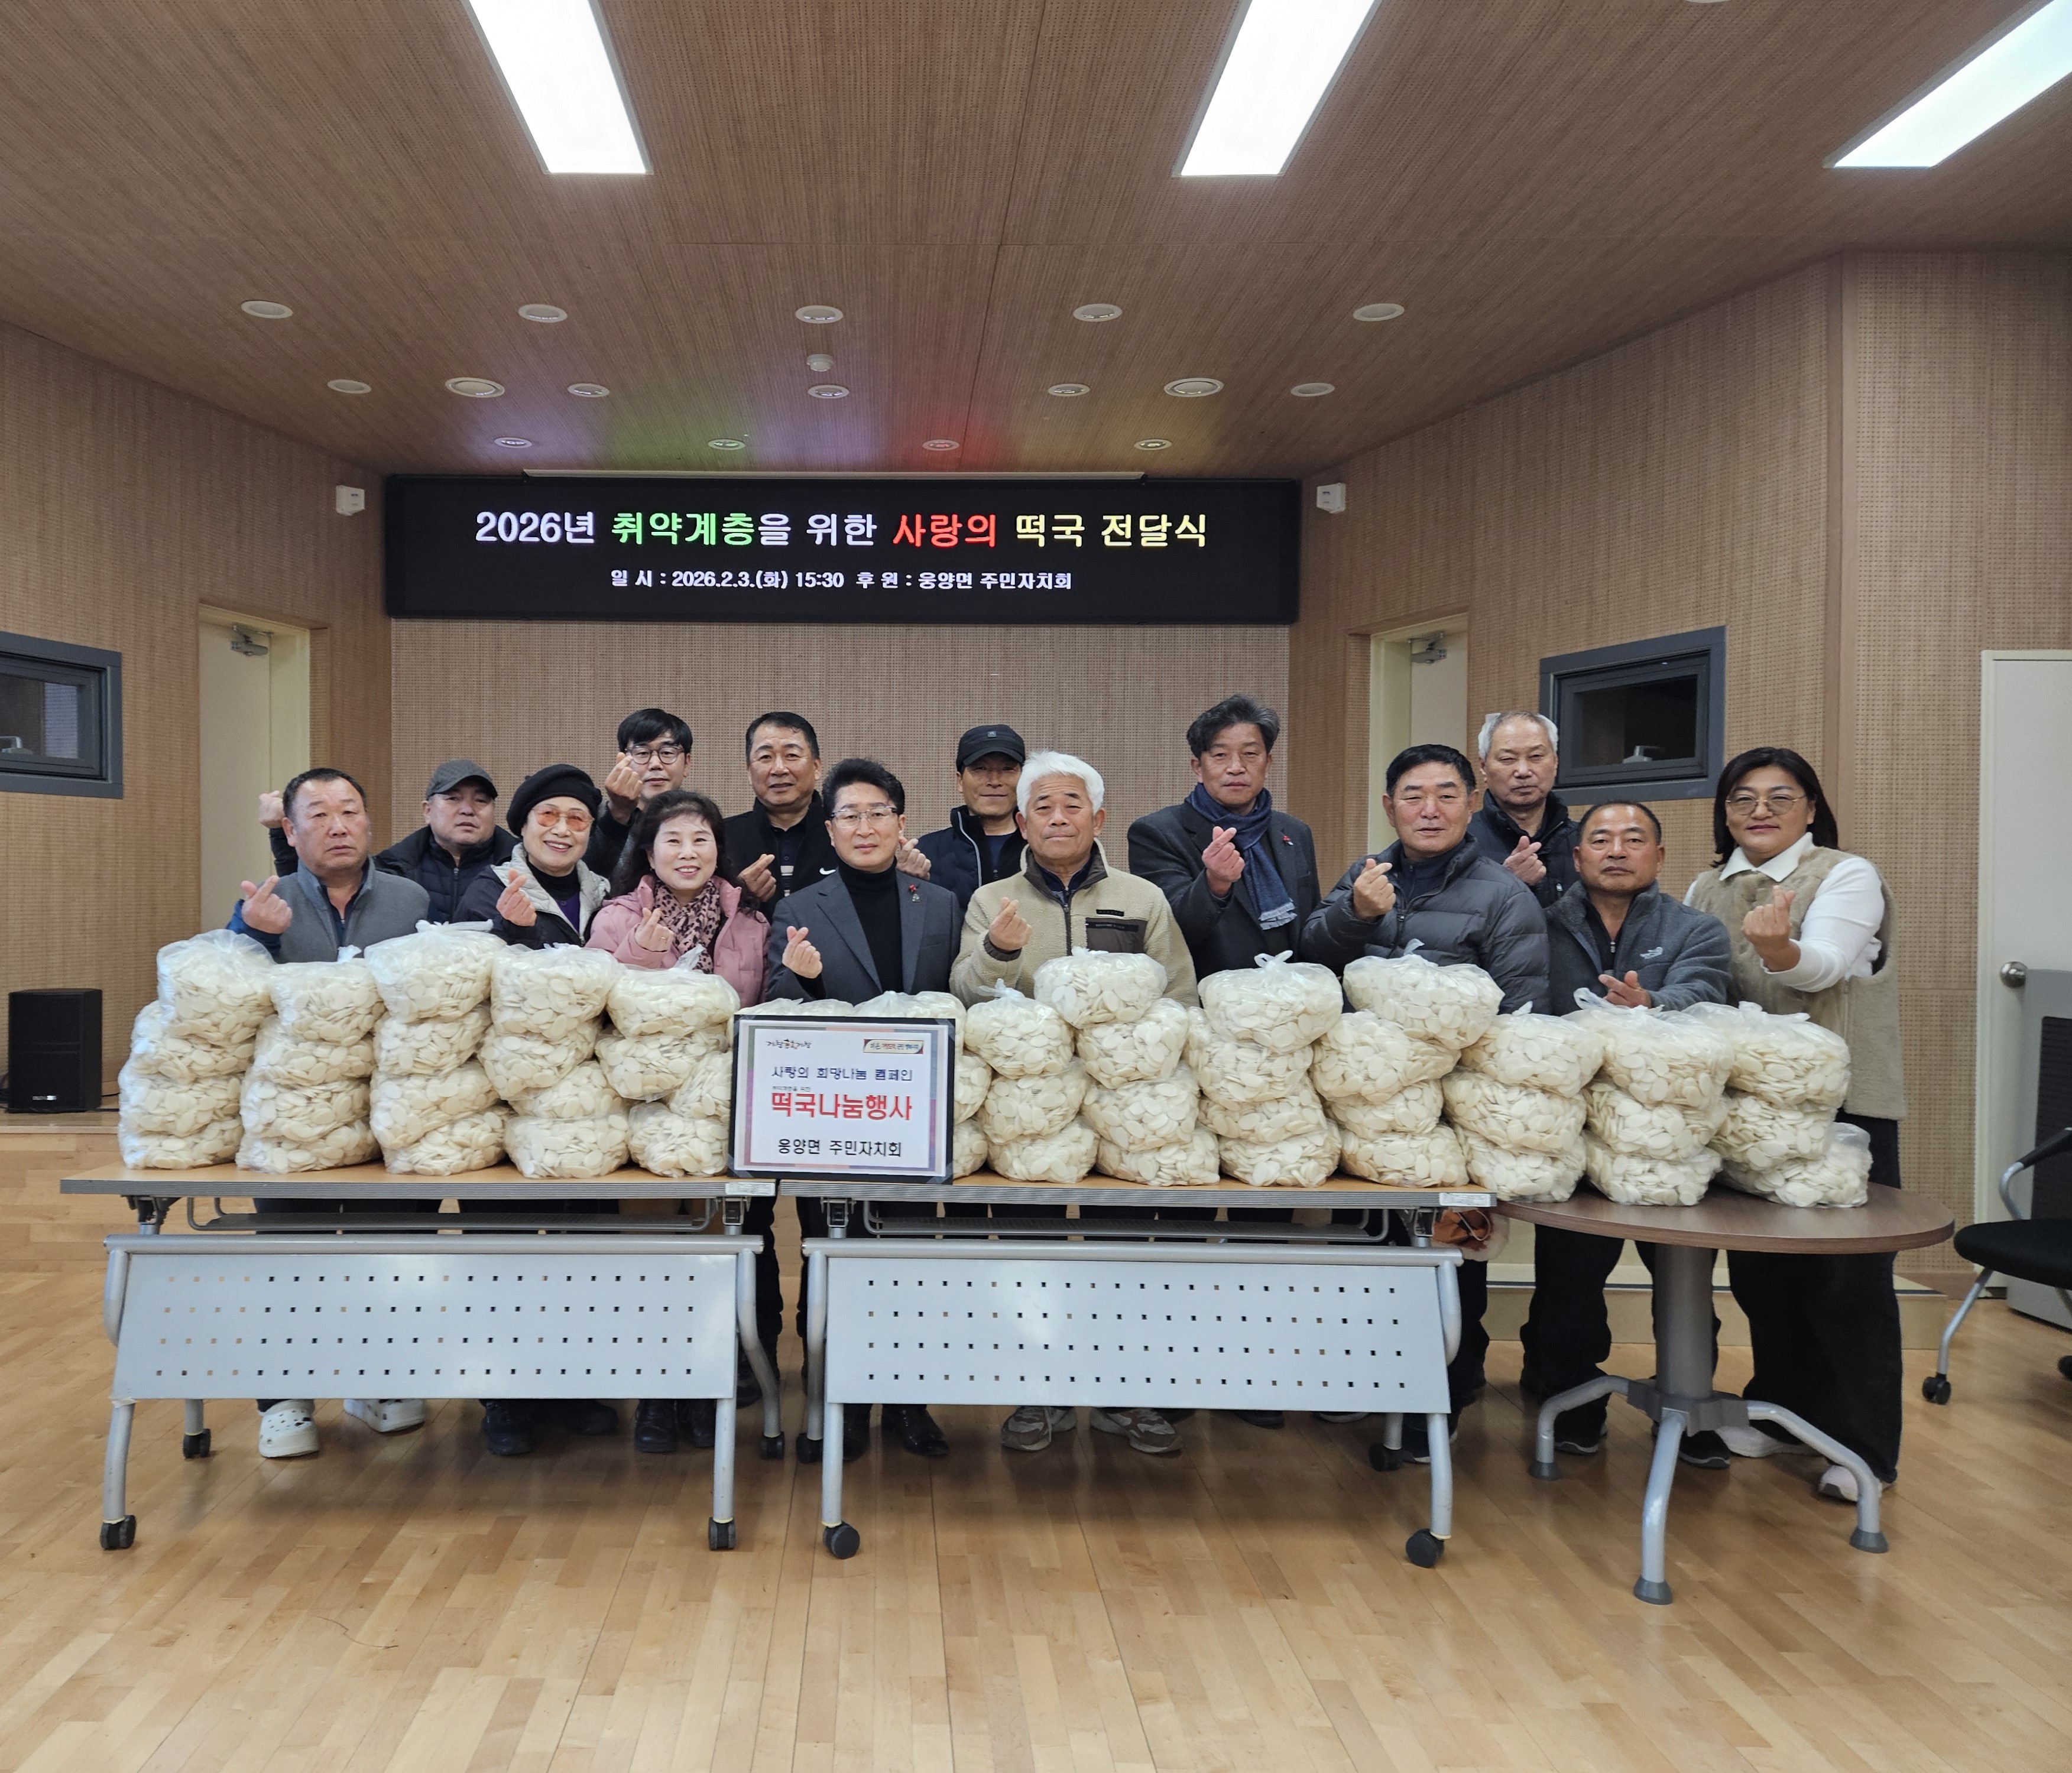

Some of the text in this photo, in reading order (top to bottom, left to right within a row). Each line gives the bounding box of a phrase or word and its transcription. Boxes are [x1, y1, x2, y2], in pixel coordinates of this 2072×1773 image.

[475, 511, 1206, 548] 2026년 취약계층을 위한 사랑의 떡국 전달식
[671, 570, 789, 589] 2026.2.3.(화)
[795, 571, 845, 588] 15:30
[917, 571, 973, 590] 웅양면
[980, 572, 1071, 590] 주민자치회
[771, 1066, 809, 1079] 사랑의
[816, 1067, 867, 1080] 희망나눔
[771, 1092, 912, 1121] 떡국나눔행사
[829, 1140, 902, 1157] 주민자치회
